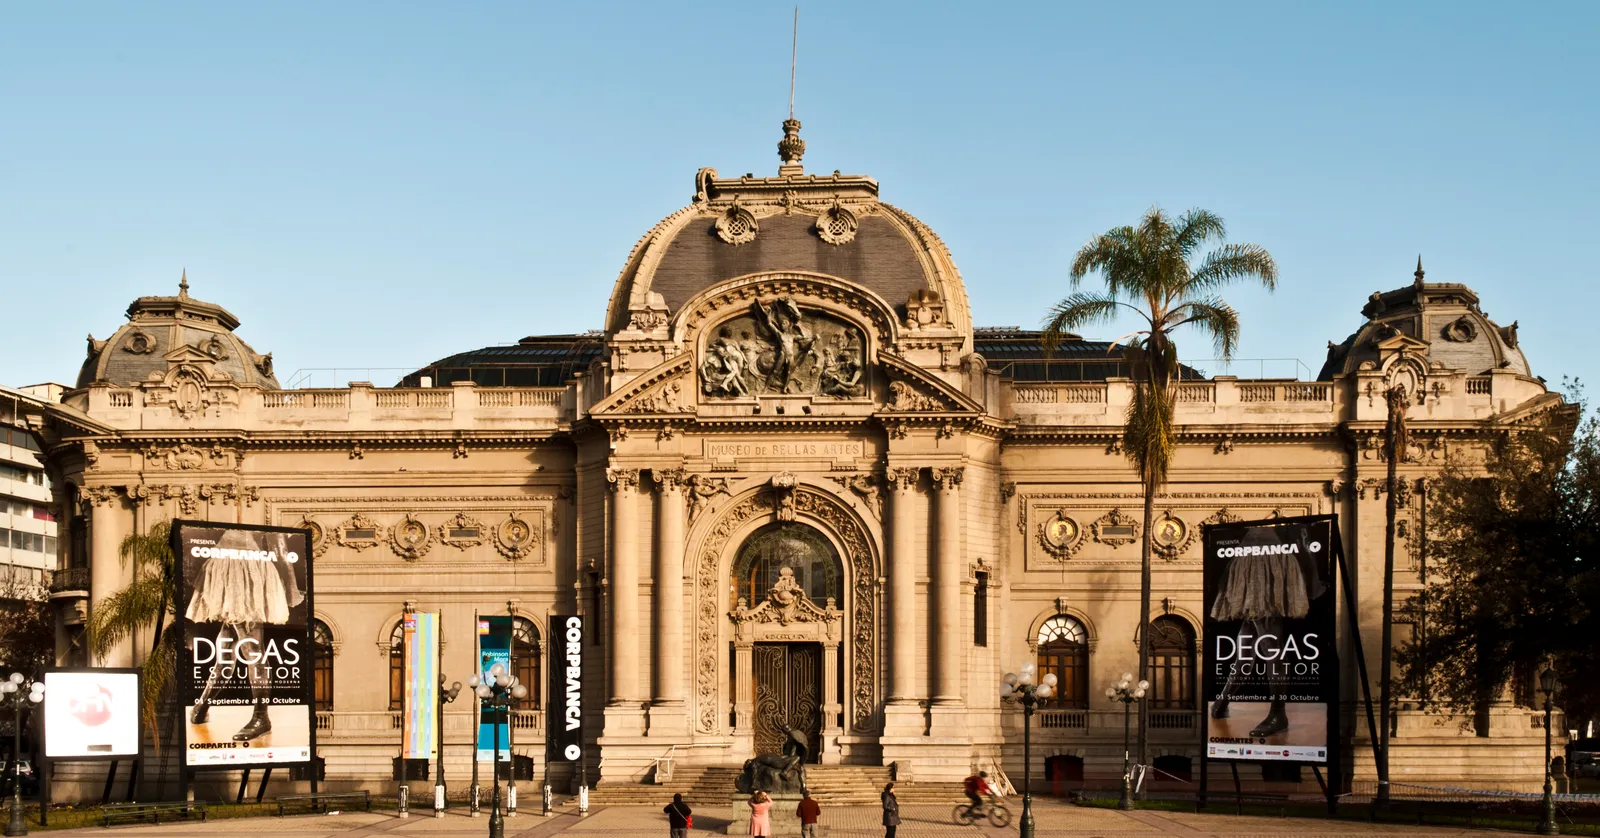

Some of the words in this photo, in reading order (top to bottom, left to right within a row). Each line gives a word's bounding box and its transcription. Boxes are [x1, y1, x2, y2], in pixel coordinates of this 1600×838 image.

[711, 445, 751, 456] MUSEO
[756, 447, 767, 456] DE
[772, 445, 817, 456] BELLAS
[823, 444, 860, 455] ARTES
[190, 546, 278, 562] CORPBANCA
[1216, 543, 1299, 558] CORPBANCA
[193, 636, 300, 665] DEGAS
[1216, 633, 1320, 661] DEGAS
[193, 666, 300, 679] ESCULTOR
[565, 616, 582, 732] CORPBANCA
[1215, 662, 1320, 675] ESCULTOR
[207, 697, 250, 705] Septiembre
[1227, 693, 1267, 701] Septiembre
[1209, 736, 1254, 744] CORPARTES
